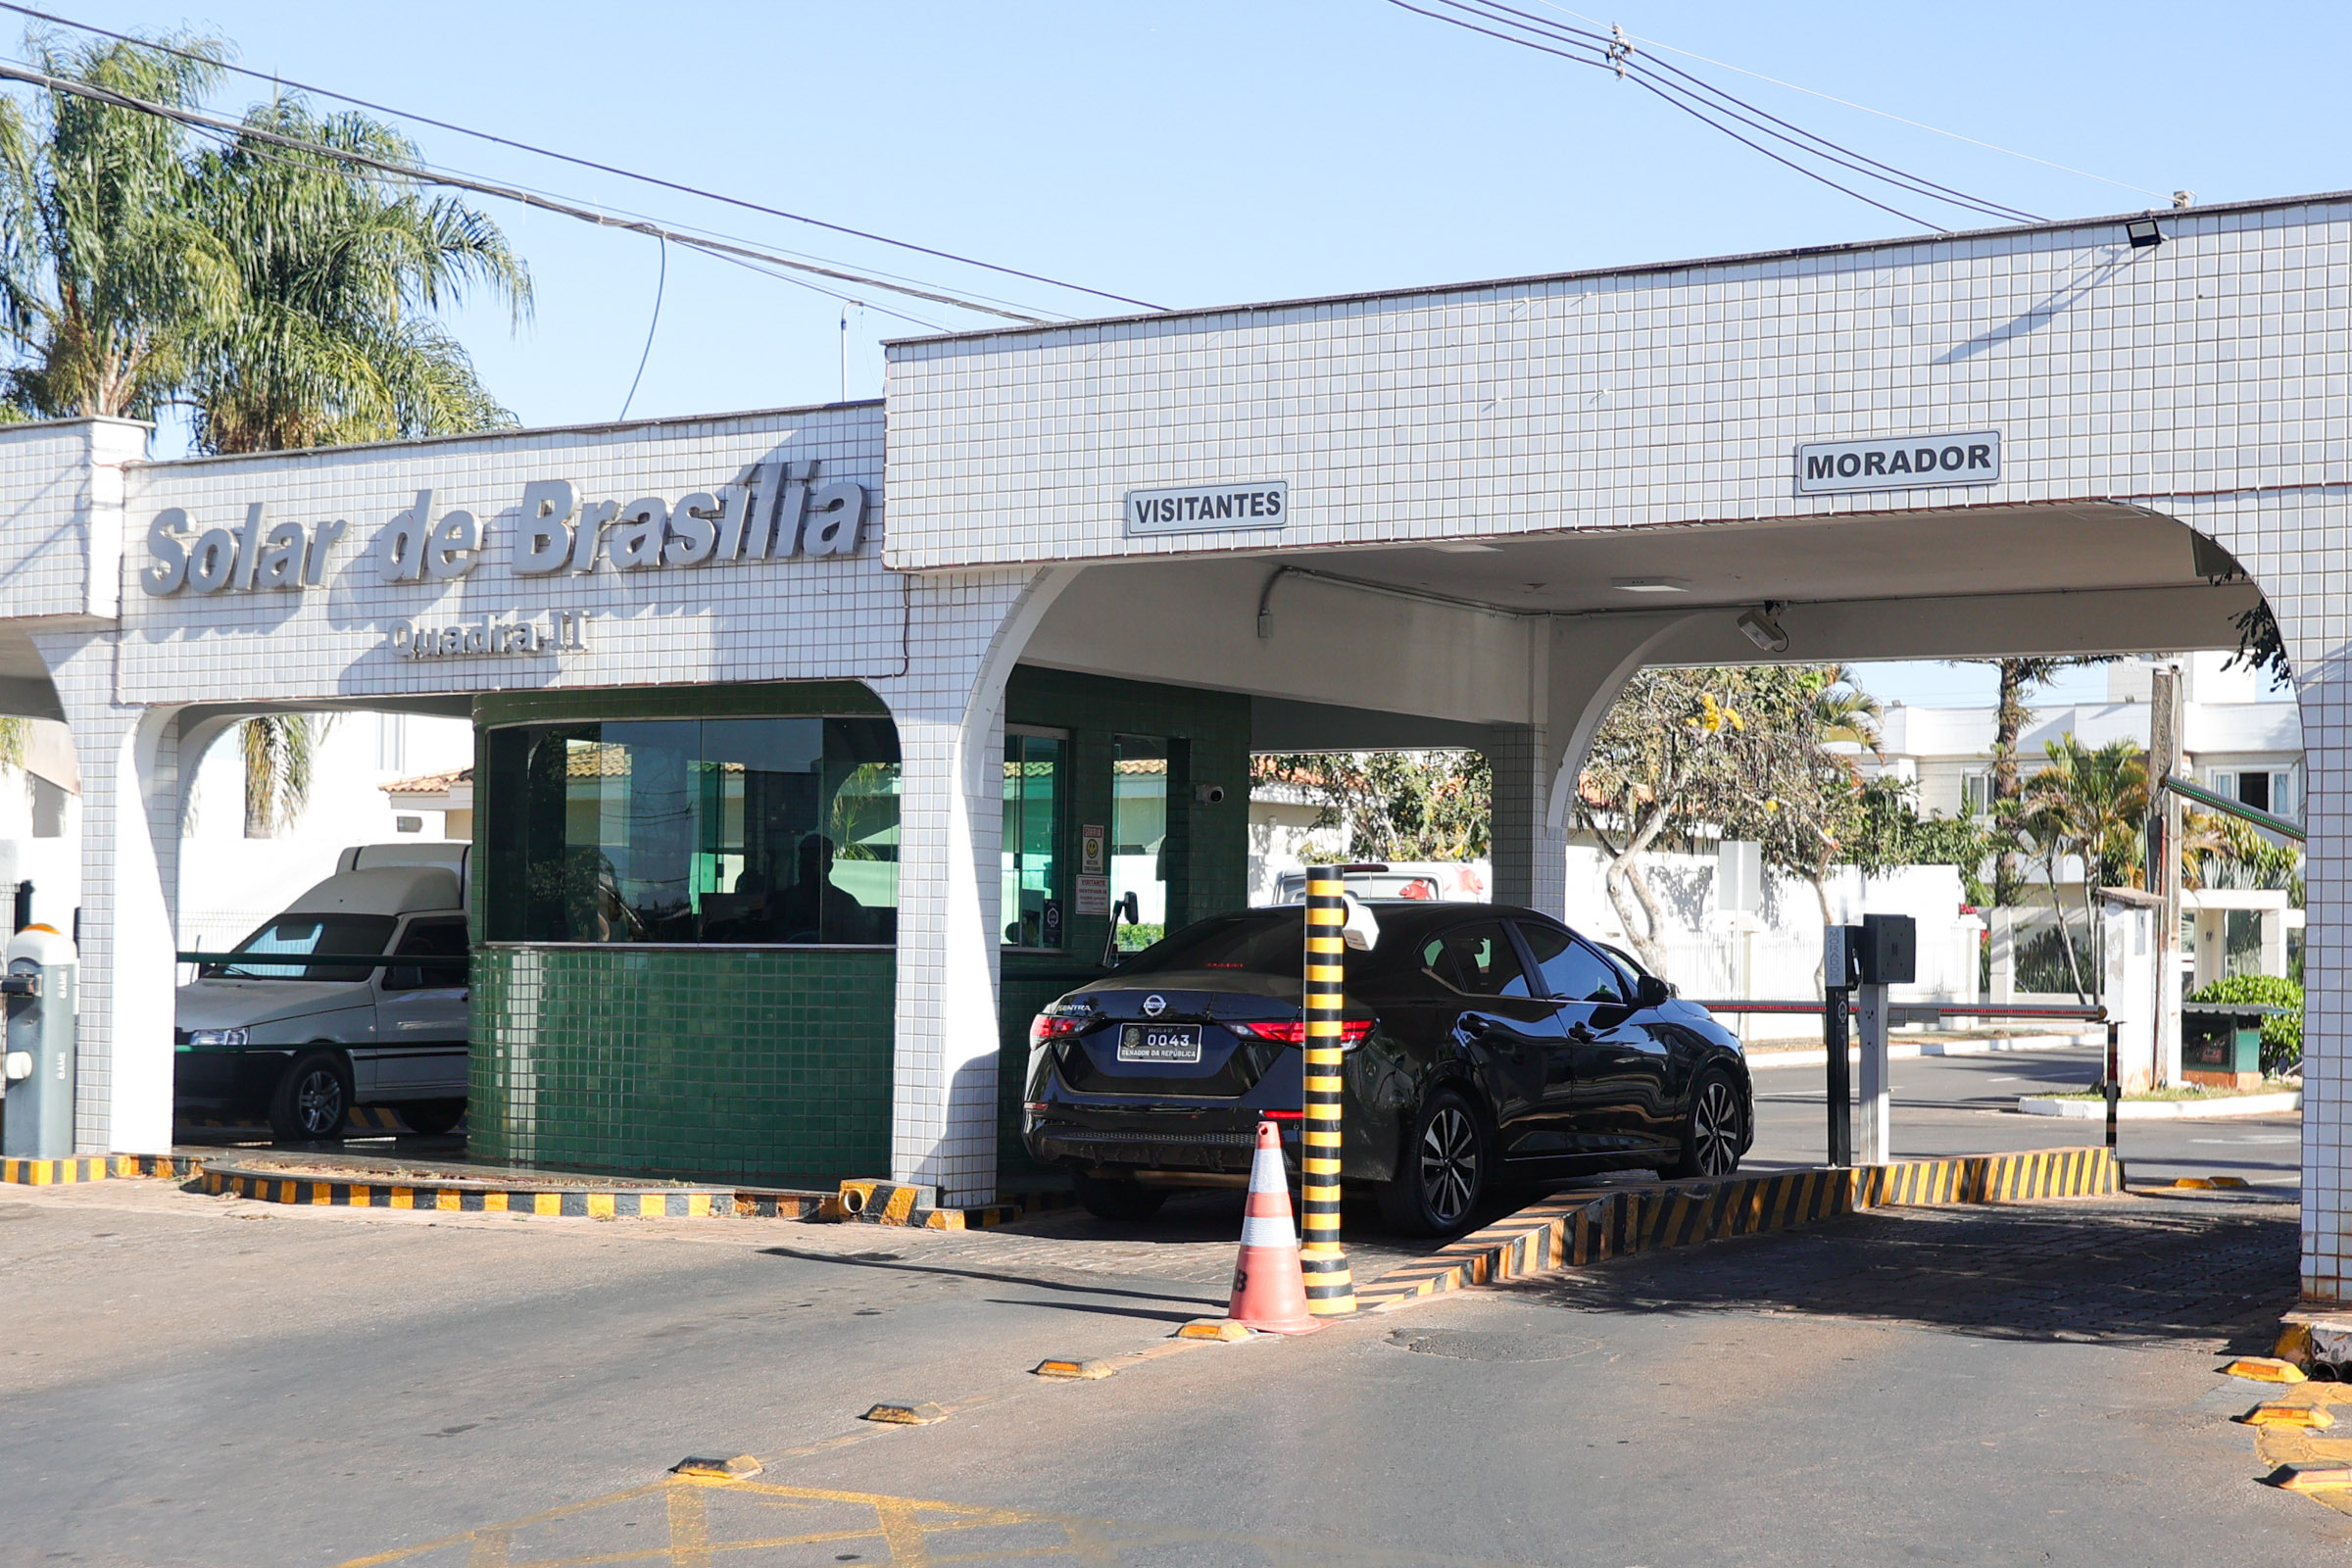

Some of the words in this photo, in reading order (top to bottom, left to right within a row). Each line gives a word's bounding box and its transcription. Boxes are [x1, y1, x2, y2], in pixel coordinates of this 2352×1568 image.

[1807, 444, 1992, 480] MORADOR
[1136, 491, 1281, 523] VISITANTES
[140, 501, 353, 597] Solar
[378, 488, 483, 583] de
[511, 460, 866, 575] Brasília
[389, 613, 545, 660] Quadra
[1828, 929, 1840, 980] MORADOR
[1148, 1034, 1190, 1047] 0043
[1161, 1049, 1196, 1057] REPÚBLICA
